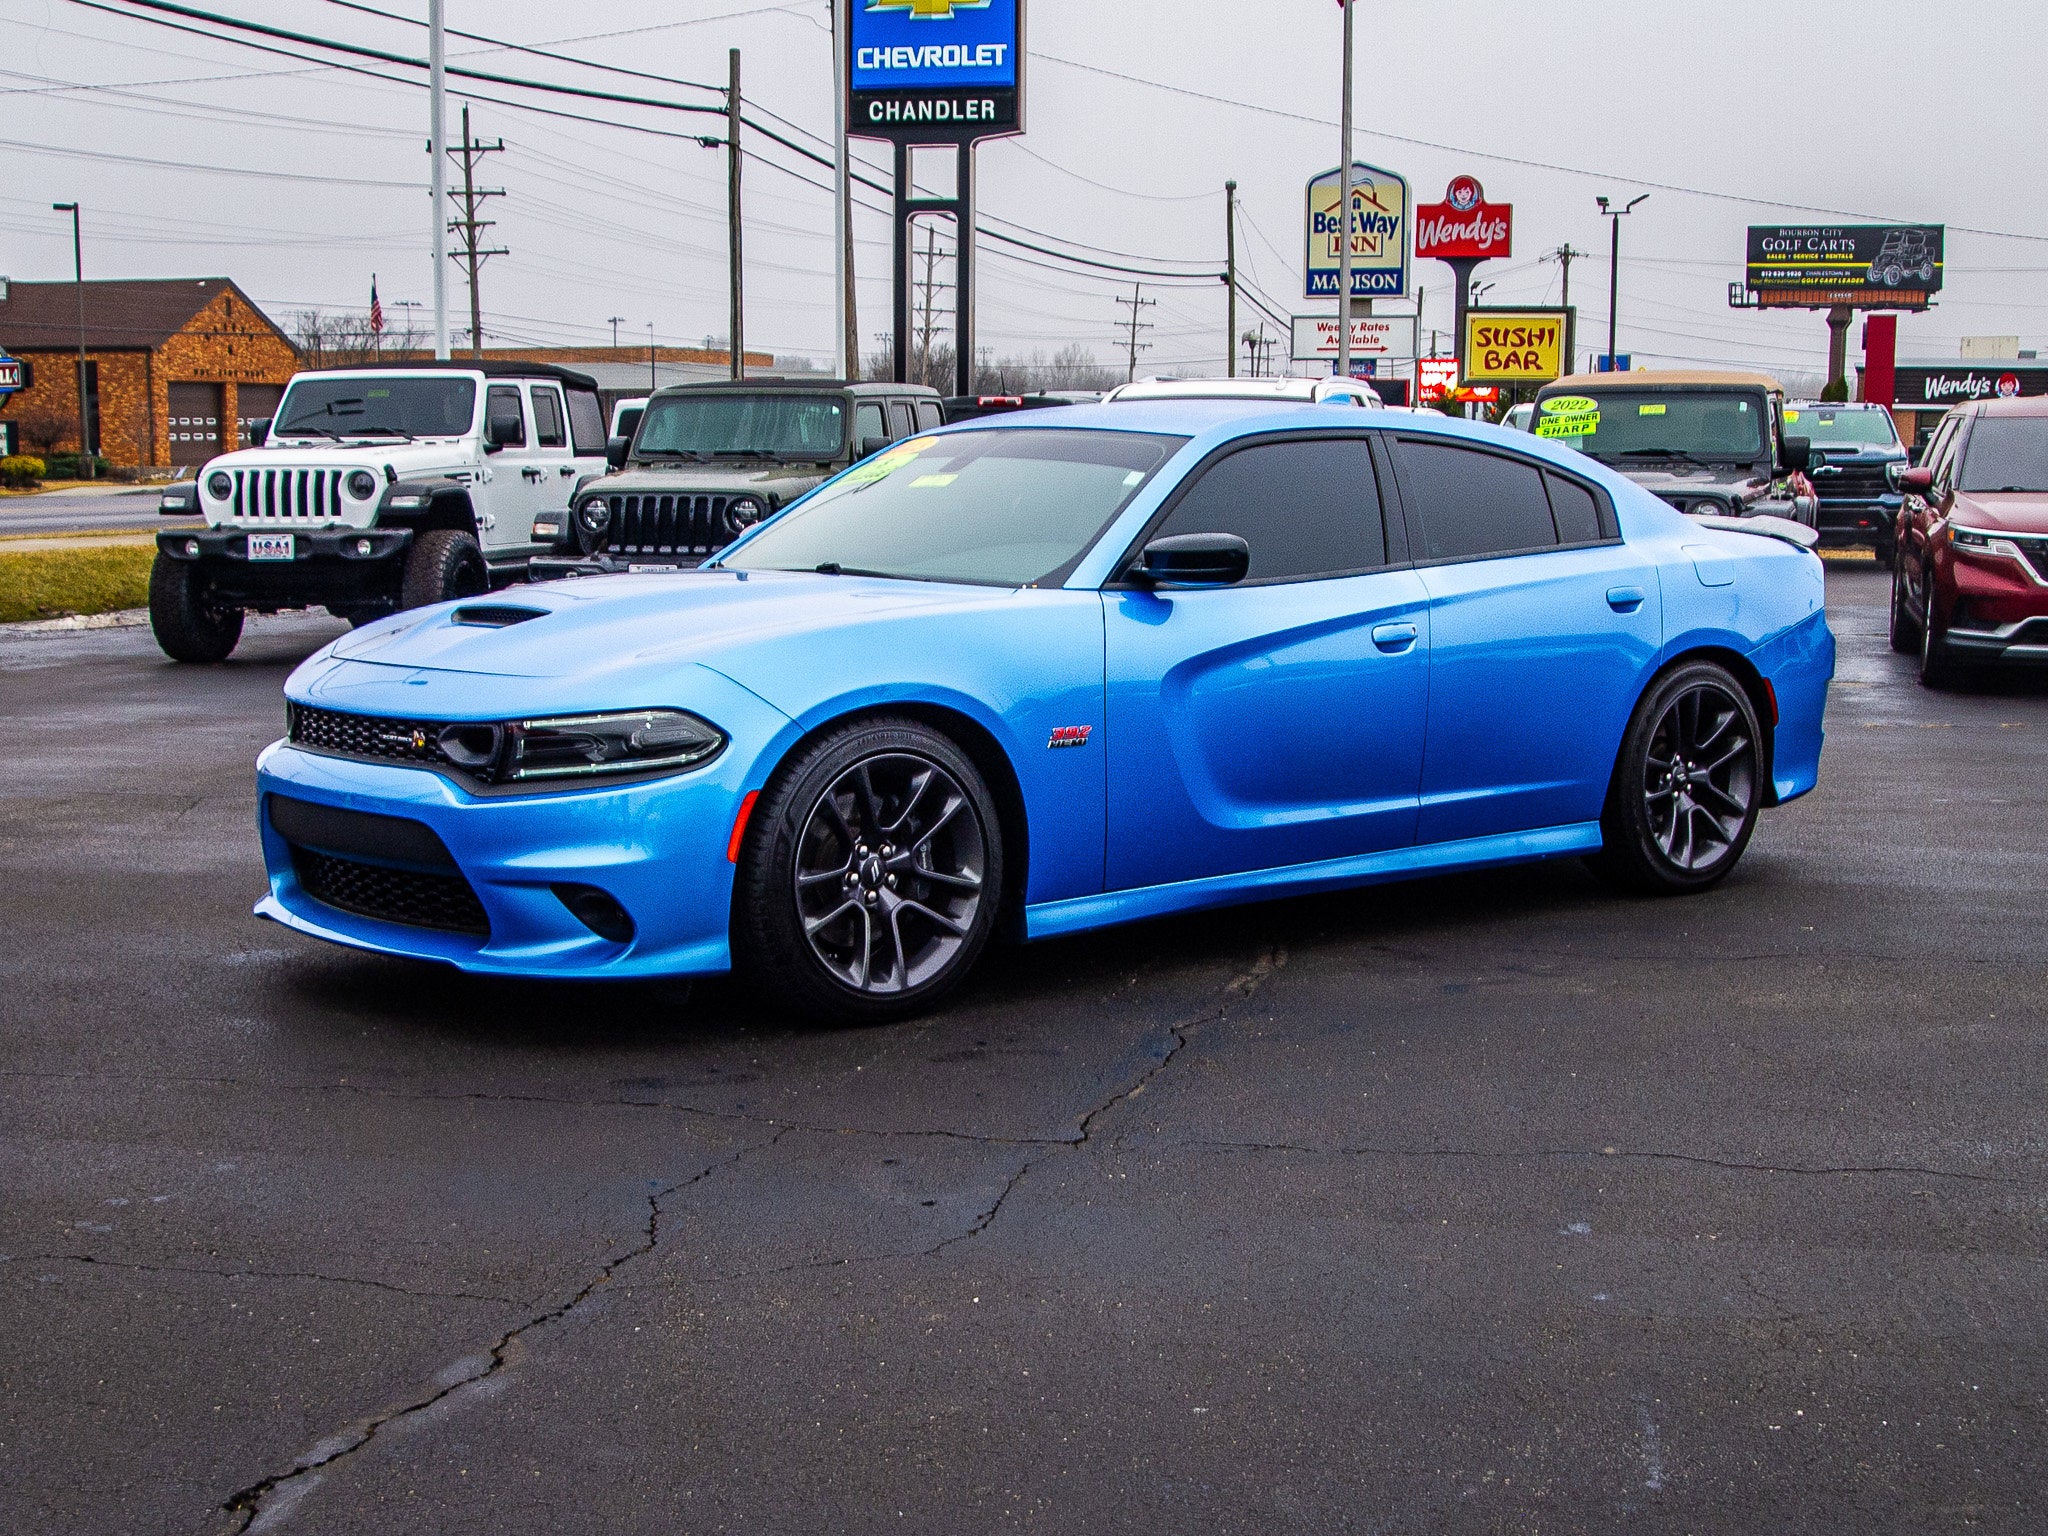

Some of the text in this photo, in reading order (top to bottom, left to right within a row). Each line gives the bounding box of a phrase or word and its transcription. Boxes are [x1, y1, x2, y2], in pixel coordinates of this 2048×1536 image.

[857, 43, 1008, 69] CHEVROLET
[868, 99, 995, 120] CHANDLER
[1313, 210, 1400, 240] Bet Way
[1418, 210, 1507, 250] Wendy's
[1311, 273, 1398, 290] MAISON
[1316, 322, 1390, 334] Weey Rates
[1476, 327, 1555, 348] SUSHI
[1326, 335, 1380, 345] Avilable
[1484, 350, 1543, 370] BAR
[1925, 372, 1991, 400] Wendy's
[1551, 400, 1588, 410] 2022
[1541, 413, 1598, 425] ONE OWNER
[1543, 424, 1589, 435] SHARP
